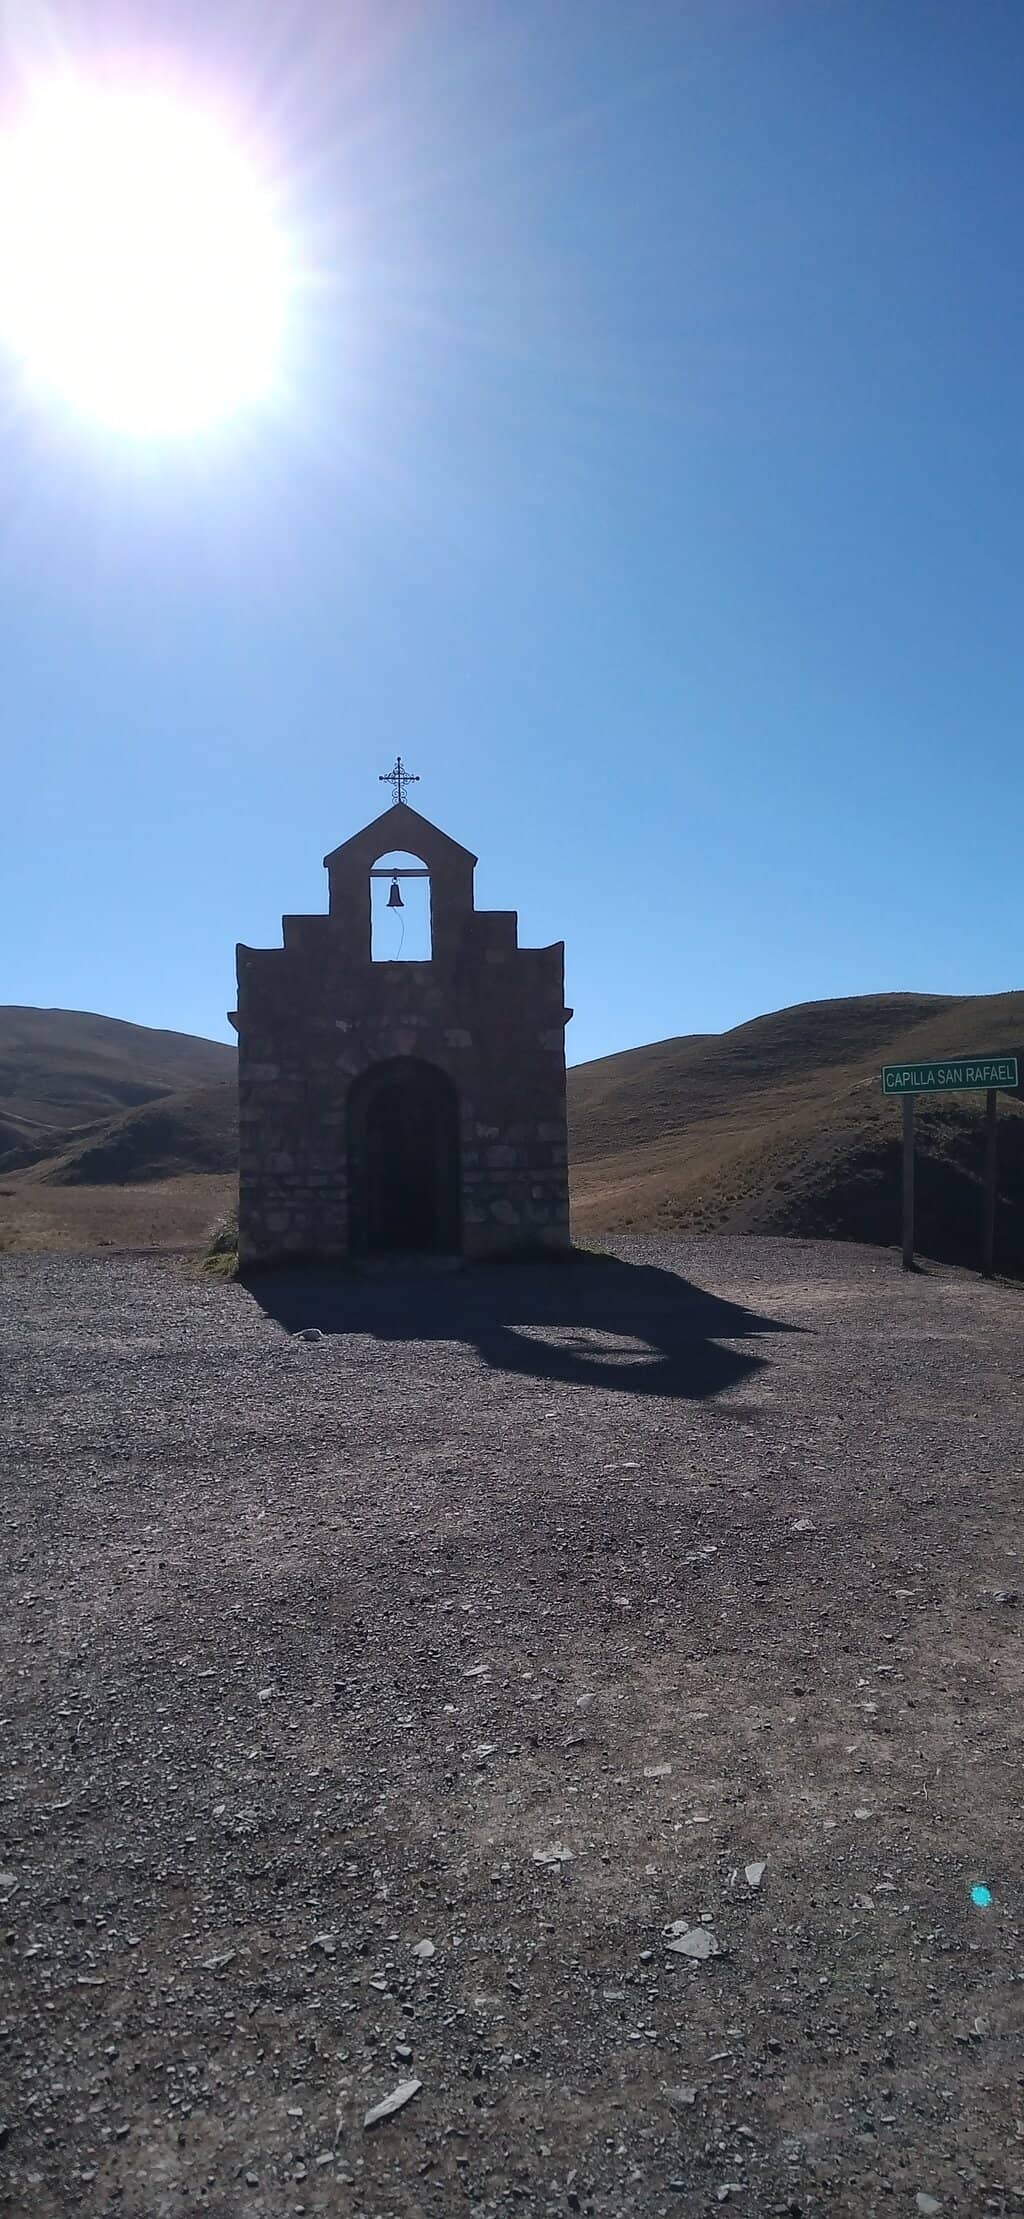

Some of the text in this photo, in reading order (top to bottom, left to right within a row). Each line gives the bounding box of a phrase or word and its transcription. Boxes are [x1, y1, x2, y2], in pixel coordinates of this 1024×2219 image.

[886, 1065, 1014, 1087] CAPILLA SAN RAFAEL
